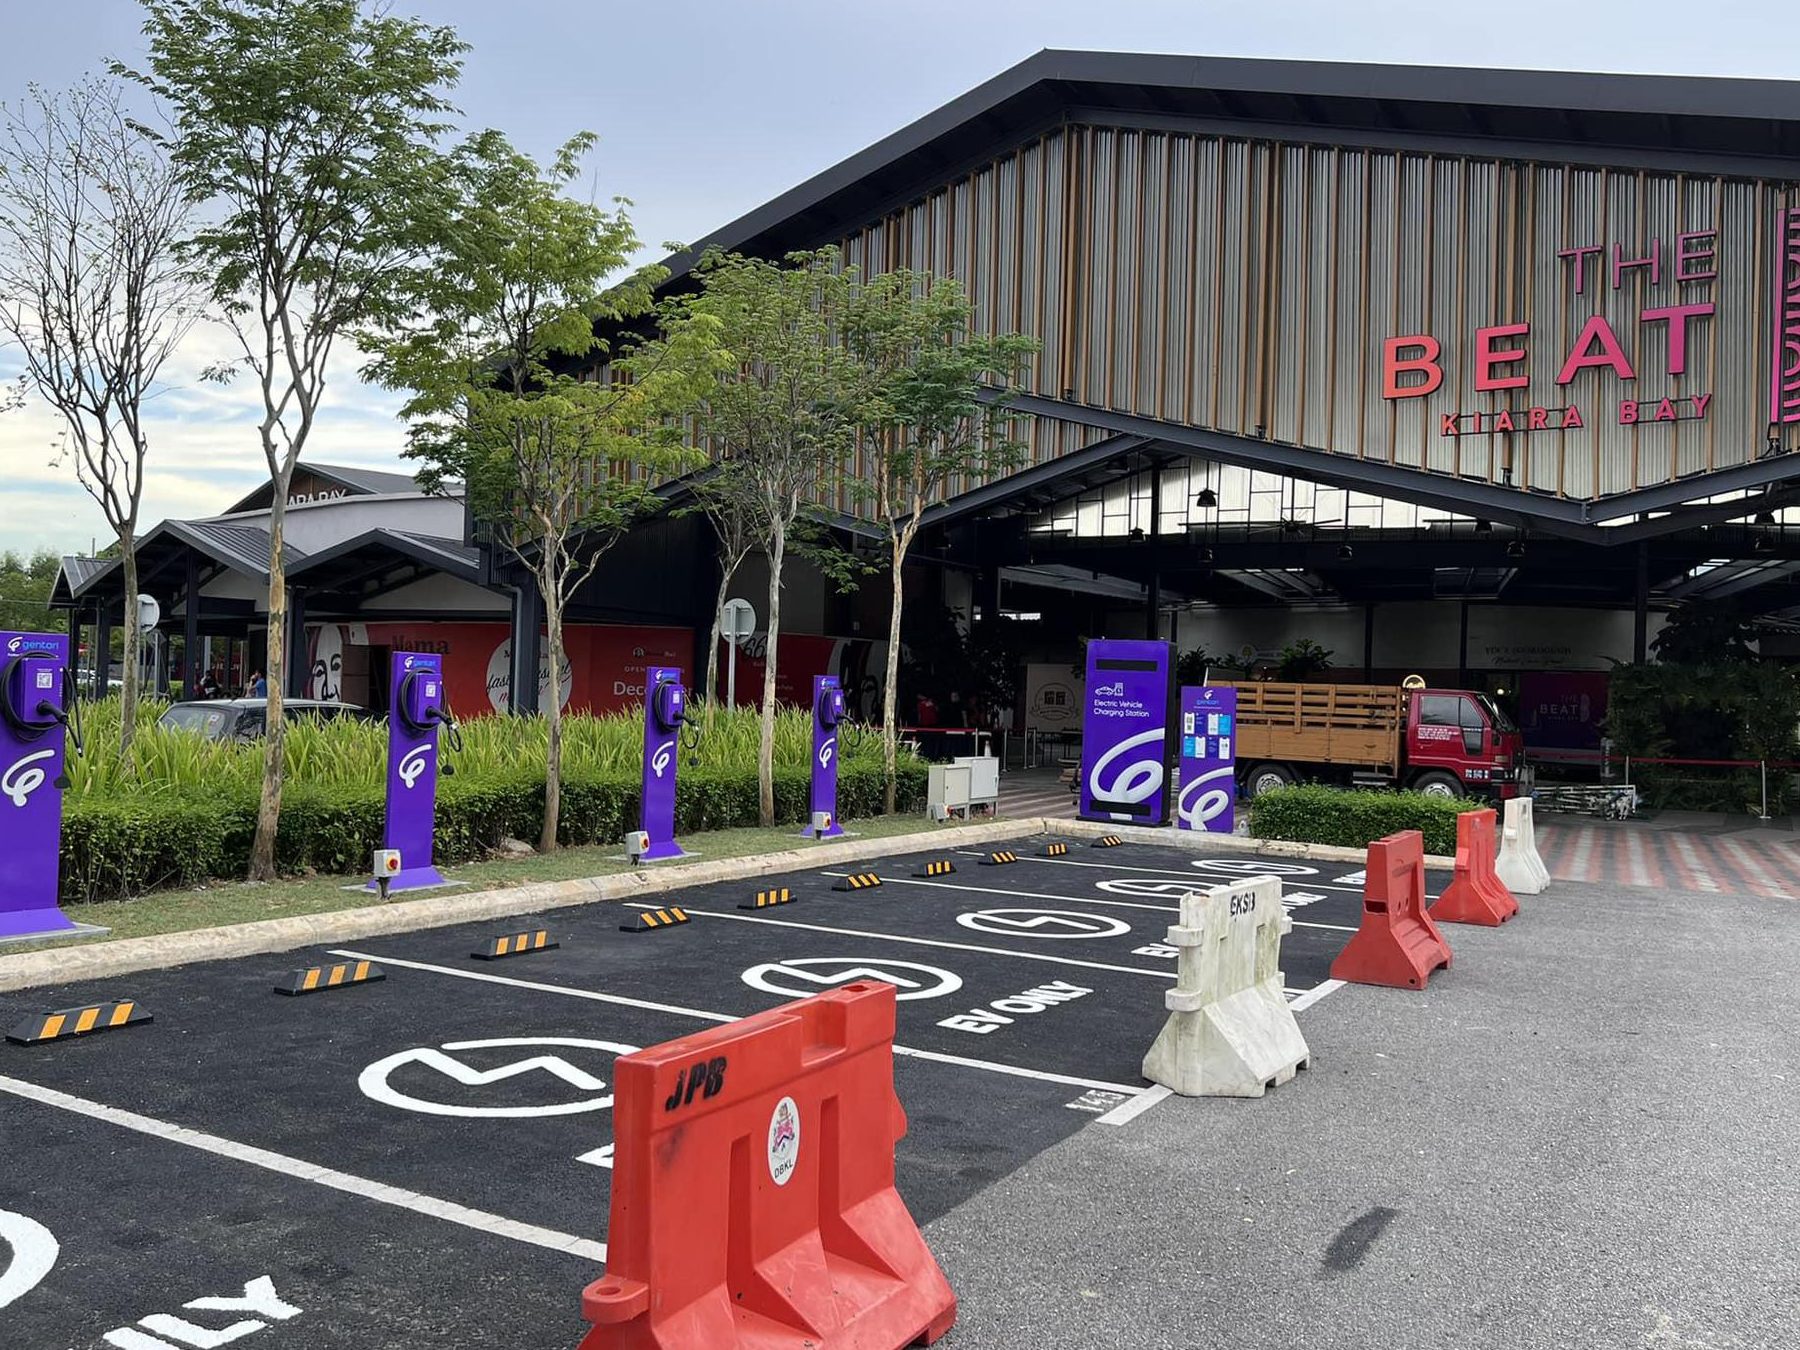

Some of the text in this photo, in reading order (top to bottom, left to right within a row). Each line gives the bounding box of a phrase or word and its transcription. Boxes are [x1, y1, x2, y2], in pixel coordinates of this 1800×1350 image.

[1557, 230, 1717, 295] THE
[1382, 302, 1716, 400] BEAT
[1440, 393, 1712, 436] KIARA BAY
[1093, 708, 1150, 718] Charging Station
[1094, 699, 1143, 709] Electric Vehicle
[1539, 704, 1579, 715] BEAT
[936, 980, 1094, 1034] EV ONLY
[774, 1160, 794, 1179] DBKL
